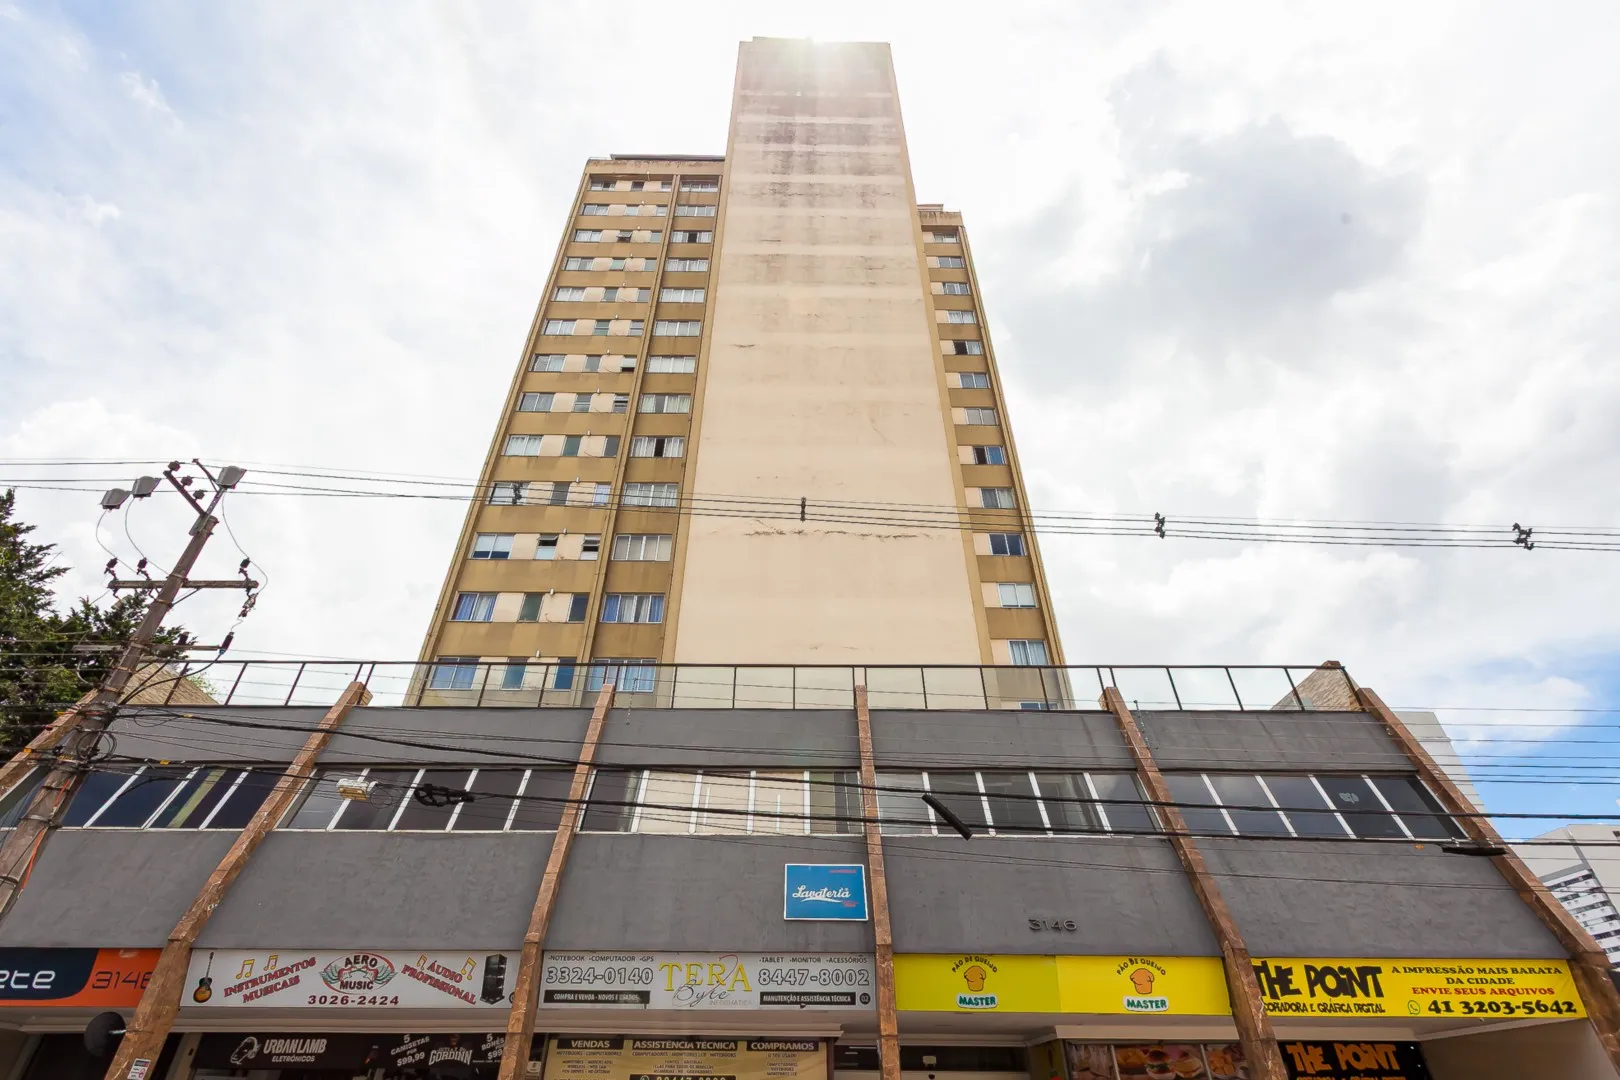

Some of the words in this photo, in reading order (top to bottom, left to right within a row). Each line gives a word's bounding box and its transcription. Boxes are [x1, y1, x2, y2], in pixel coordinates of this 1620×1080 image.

[1028, 919, 1077, 931] 3146
[344, 955, 378, 968] AERO
[952, 960, 964, 973] PÃO
[974, 956, 998, 973] QUEIJO
[1116, 962, 1129, 975] PÃO
[1140, 958, 1166, 975] QUEIJO
[426, 960, 463, 983] ÁUDIO
[546, 966, 654, 985] 3324-0140
[1391, 966, 1401, 974] A
[1402, 965, 1474, 975] IMPRESSÃO
[1477, 967, 1509, 975] MAIS
[1511, 967, 1563, 975] BARATA
[223, 956, 317, 998] INSTRUMENTOS
[658, 962, 753, 992] TERA
[758, 968, 870, 986] 8447-8002
[1252, 960, 1302, 1000] THE
[1304, 964, 1384, 998] POINT
[1445, 977, 1464, 985] DA
[1466, 977, 1516, 985] CIDADE
[242, 975, 300, 1003] MUSICAIS
[340, 980, 374, 990] MUSIC
[401, 964, 477, 1005] PROFISSIONAL
[1412, 987, 1452, 995] ENVIE
[1454, 987, 1487, 995] SEUS
[1490, 987, 1555, 996] ARQUIVOS
[308, 995, 399, 1005] 3026-2424
[763, 994, 797, 1003] MANUTENÇÃO
[959, 996, 996, 1006] MASTER
[1126, 999, 1167, 1009] MASTER
[1310, 1003, 1316, 1012] E
[1354, 1003, 1386, 1013] DIGITAL
[1428, 1000, 1454, 1014] 41
[1459, 999, 1577, 1015] 3203-5642
[403, 1034, 411, 1043] 5
[486, 1033, 493, 1042] 5
[390, 1036, 430, 1056] CAMISETAS
[571, 1040, 610, 1048] VENDAS
[696, 1040, 736, 1050] TÉCNICA
[751, 1042, 814, 1050] COMPRAMOS
[1285, 1041, 1332, 1074] THE
[1333, 1043, 1400, 1071] POINT
